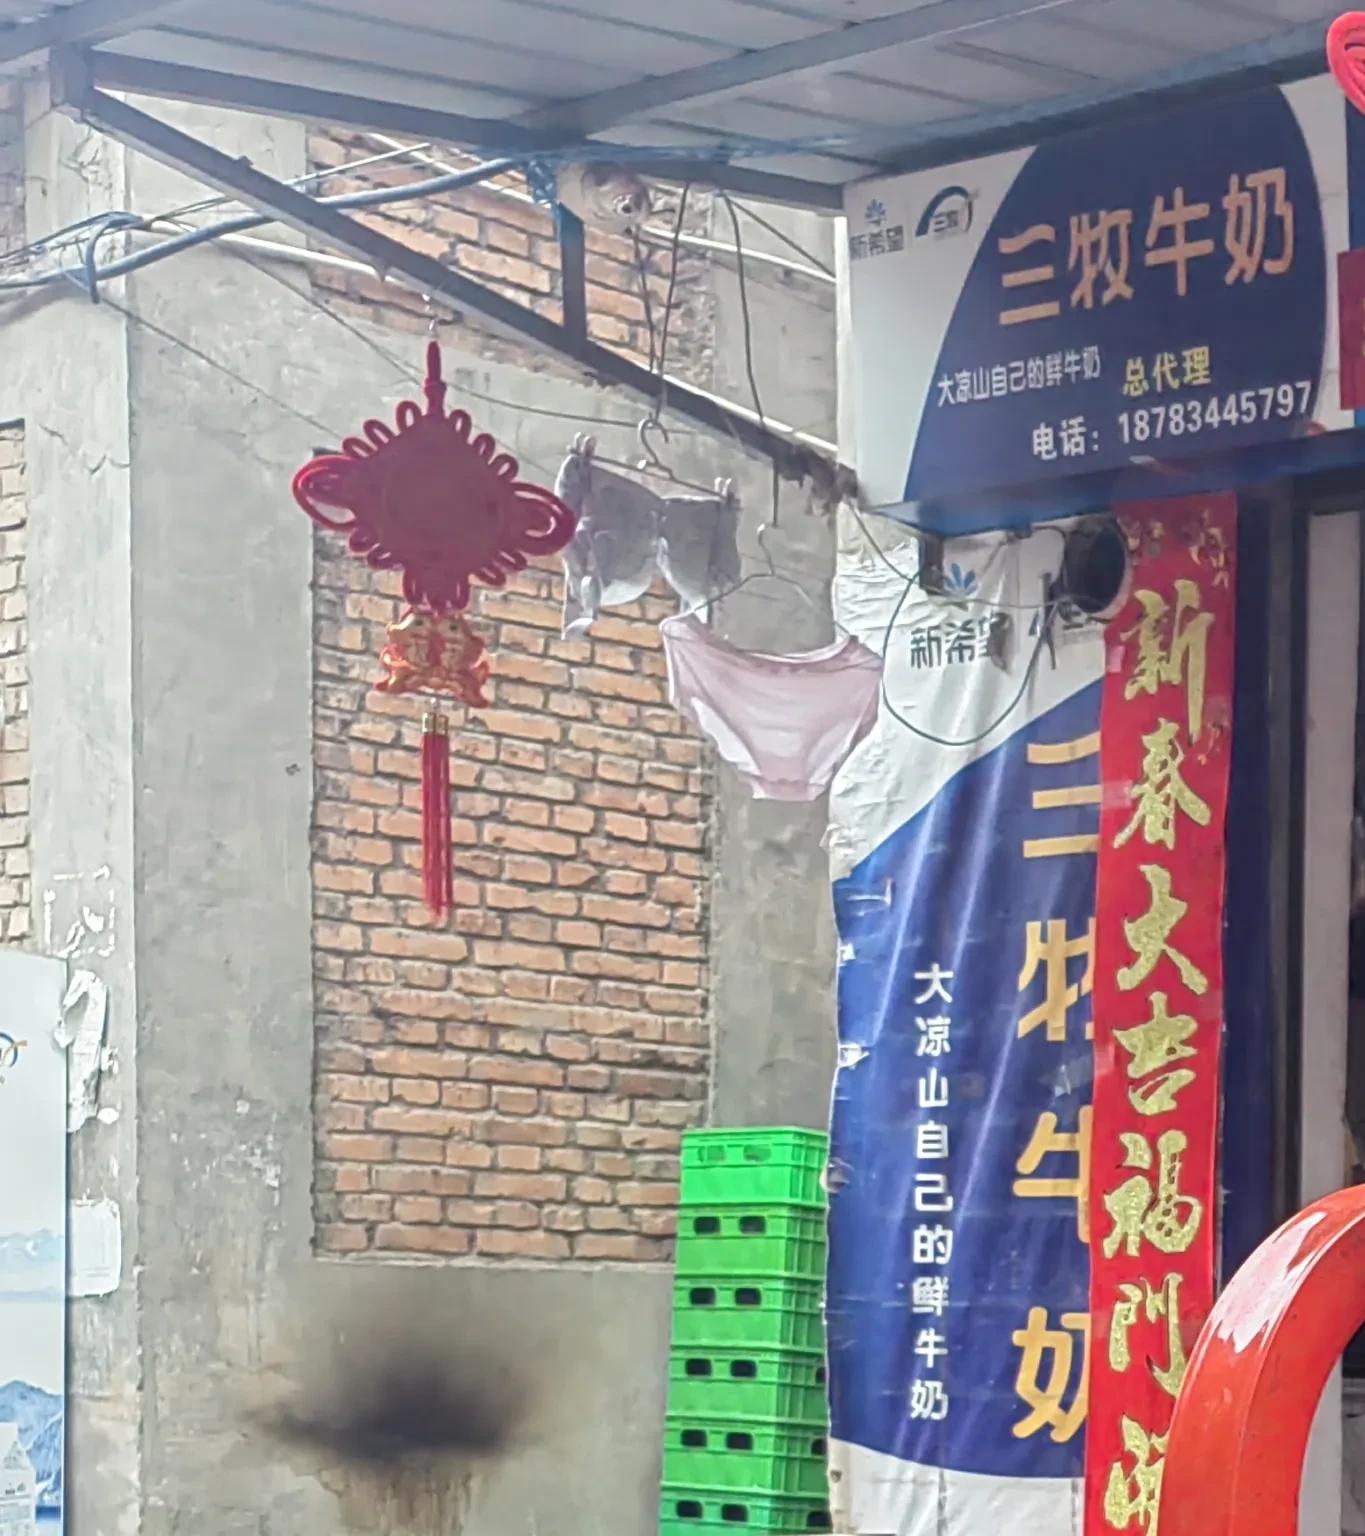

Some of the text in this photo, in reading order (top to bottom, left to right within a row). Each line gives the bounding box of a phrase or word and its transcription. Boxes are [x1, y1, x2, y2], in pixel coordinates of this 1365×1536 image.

[998, 166, 1295, 326] 三牧牛奶
[937, 345, 1101, 407] 大凉山自己的鲜牛奶
[1122, 345, 1211, 397] 总代理
[1117, 380, 1313, 445] 18783445797
[910, 963, 954, 1421] 大凉山自己的鲜牛奶
